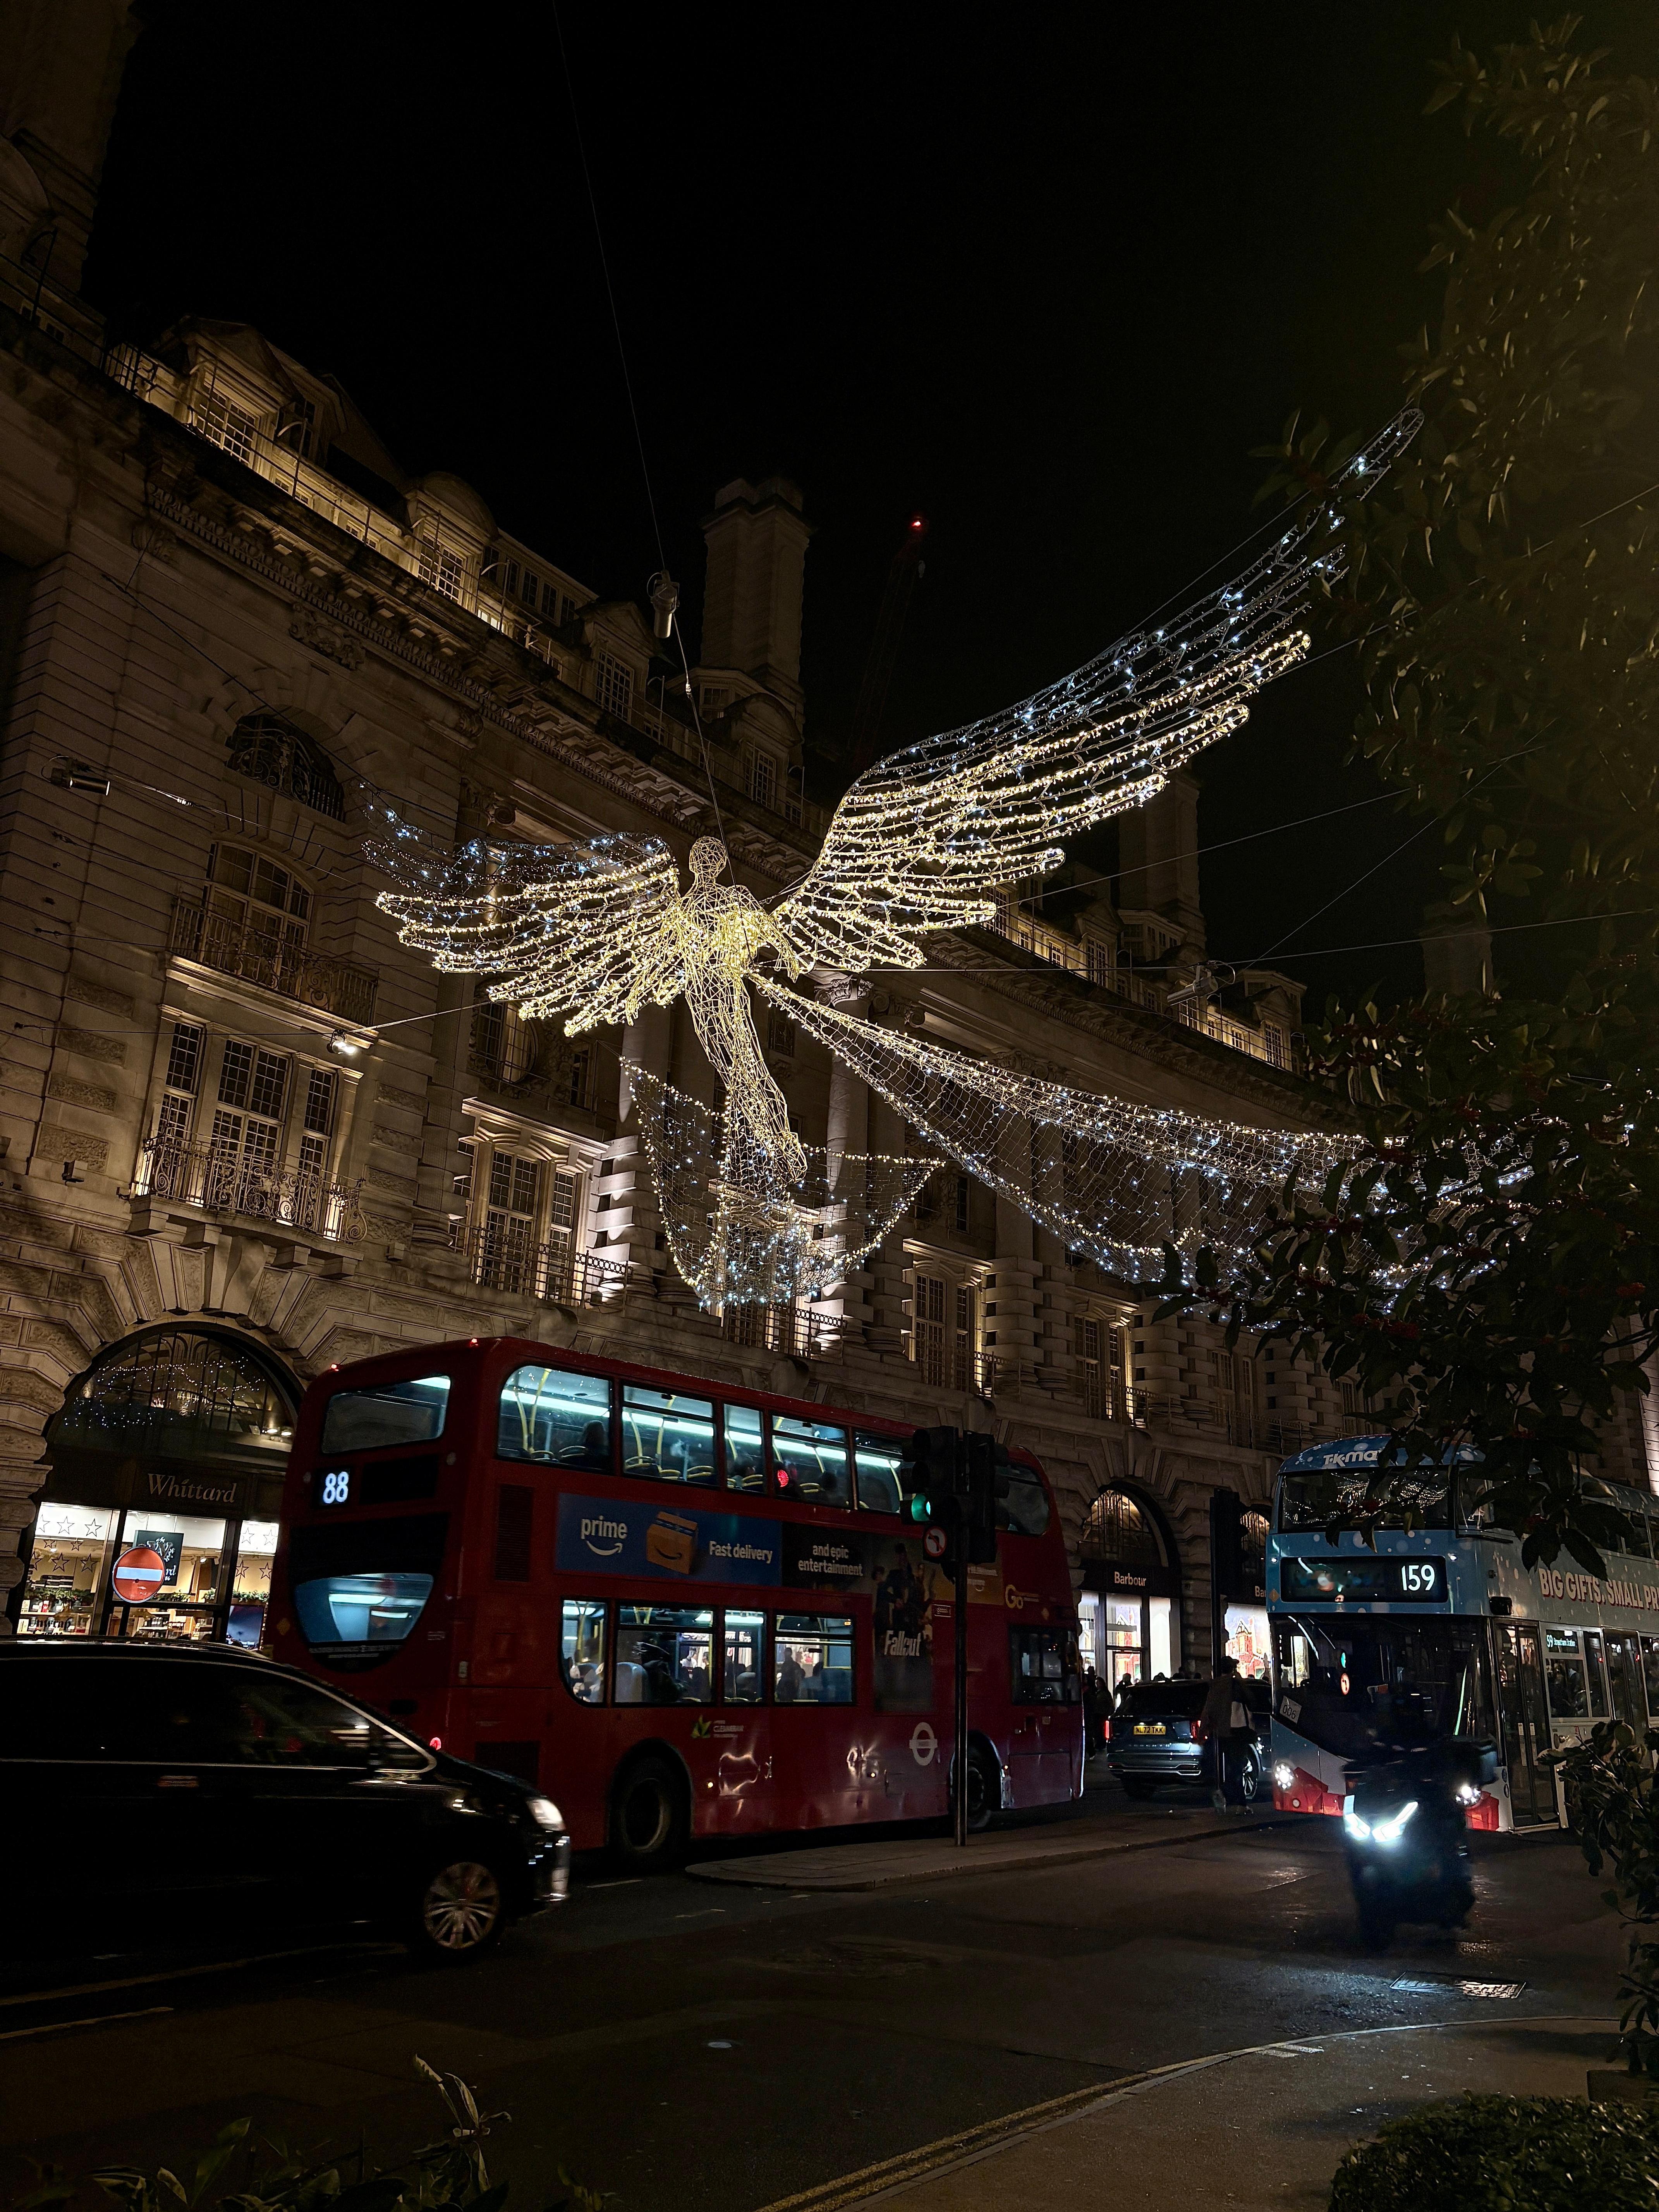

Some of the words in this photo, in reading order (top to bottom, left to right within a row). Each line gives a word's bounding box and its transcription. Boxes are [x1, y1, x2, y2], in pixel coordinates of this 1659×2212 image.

[147, 1472, 237, 1504] Whittard
[322, 1471, 349, 1504] 88
[581, 1515, 628, 1540] prime
[709, 1540, 732, 1558] Fast
[733, 1543, 773, 1564] delivery
[812, 1544, 829, 1557] and
[830, 1546, 849, 1560] epic
[798, 1559, 863, 1577] entertainment
[1114, 1571, 1147, 1587] Barbour
[1401, 1564, 1435, 1592] 159
[1539, 1568, 1564, 1599] BIG
[1606, 1579, 1644, 1609] SMALL
[884, 1630, 922, 1657] Fallout
[1283, 1704, 1296, 1719] 006
